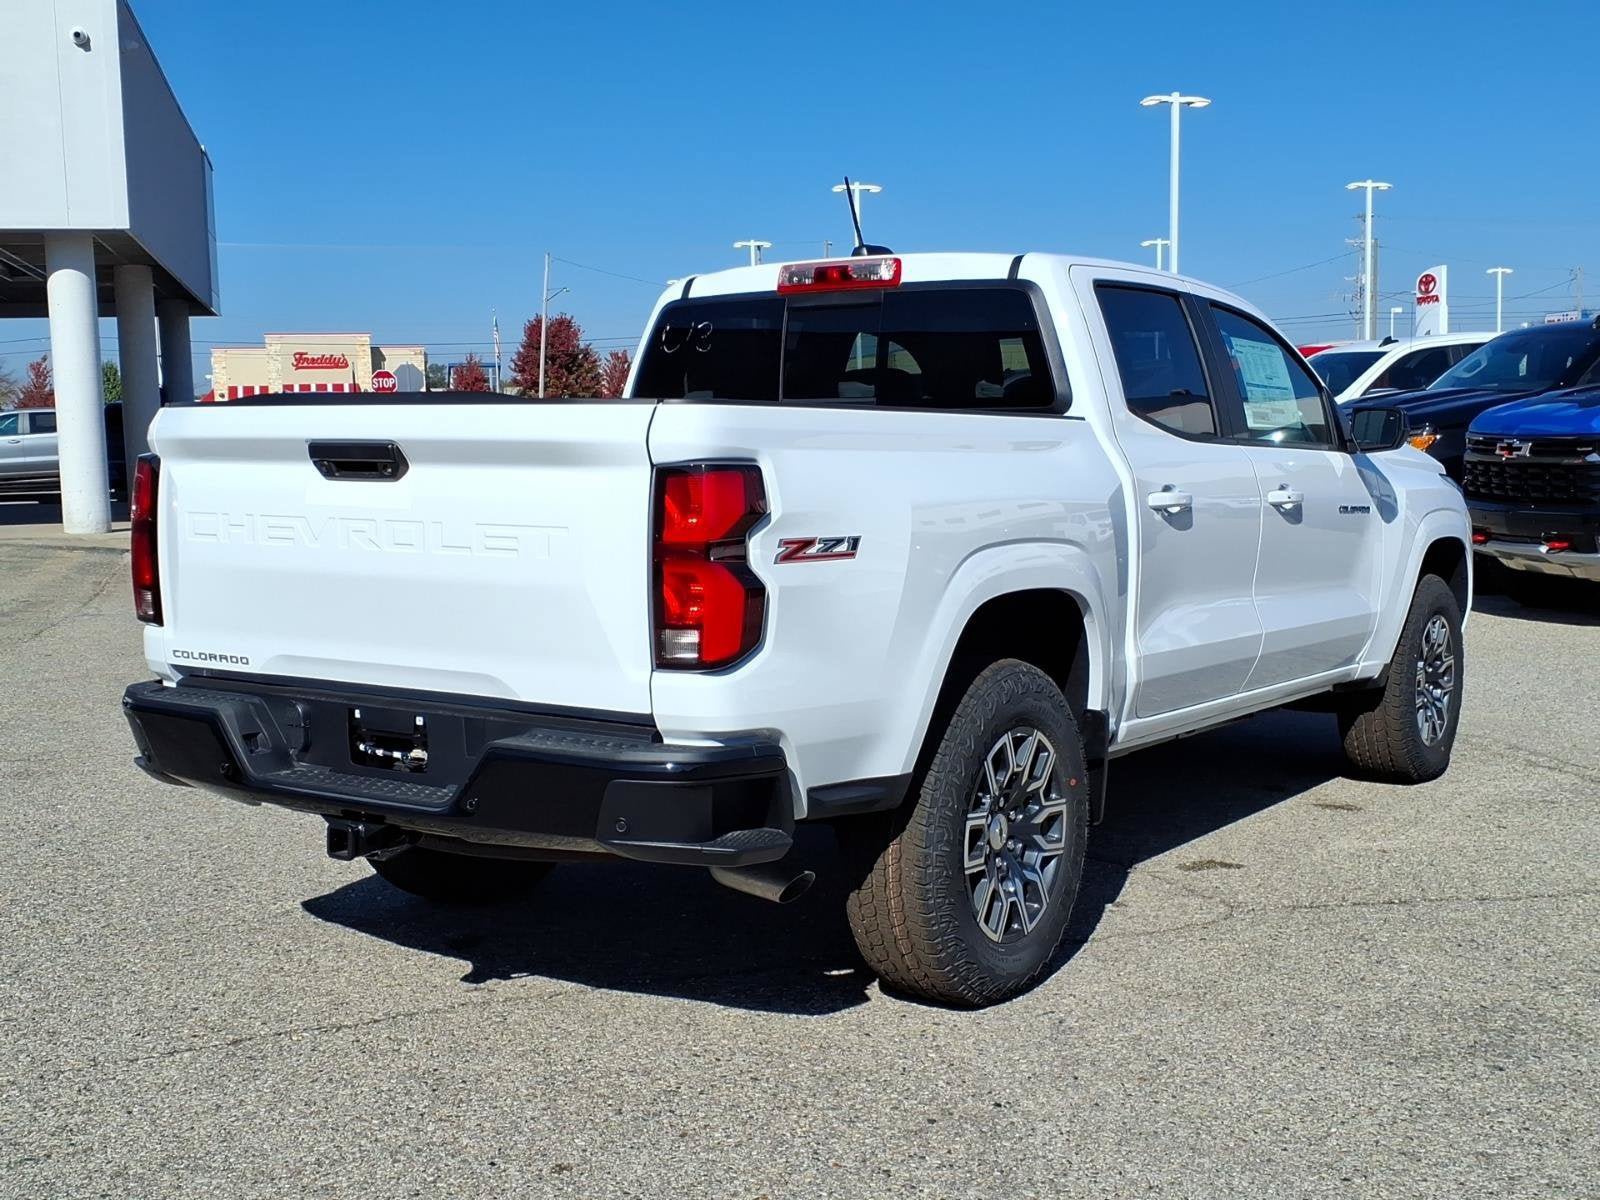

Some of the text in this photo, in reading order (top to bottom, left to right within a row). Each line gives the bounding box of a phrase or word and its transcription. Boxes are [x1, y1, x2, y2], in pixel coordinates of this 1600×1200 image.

[292, 352, 349, 370] Freddy's
[373, 378, 395, 388] STOP
[184, 510, 569, 559] CHEVROLET
[774, 535, 862, 565] Z71
[172, 649, 250, 665] COLORADO
